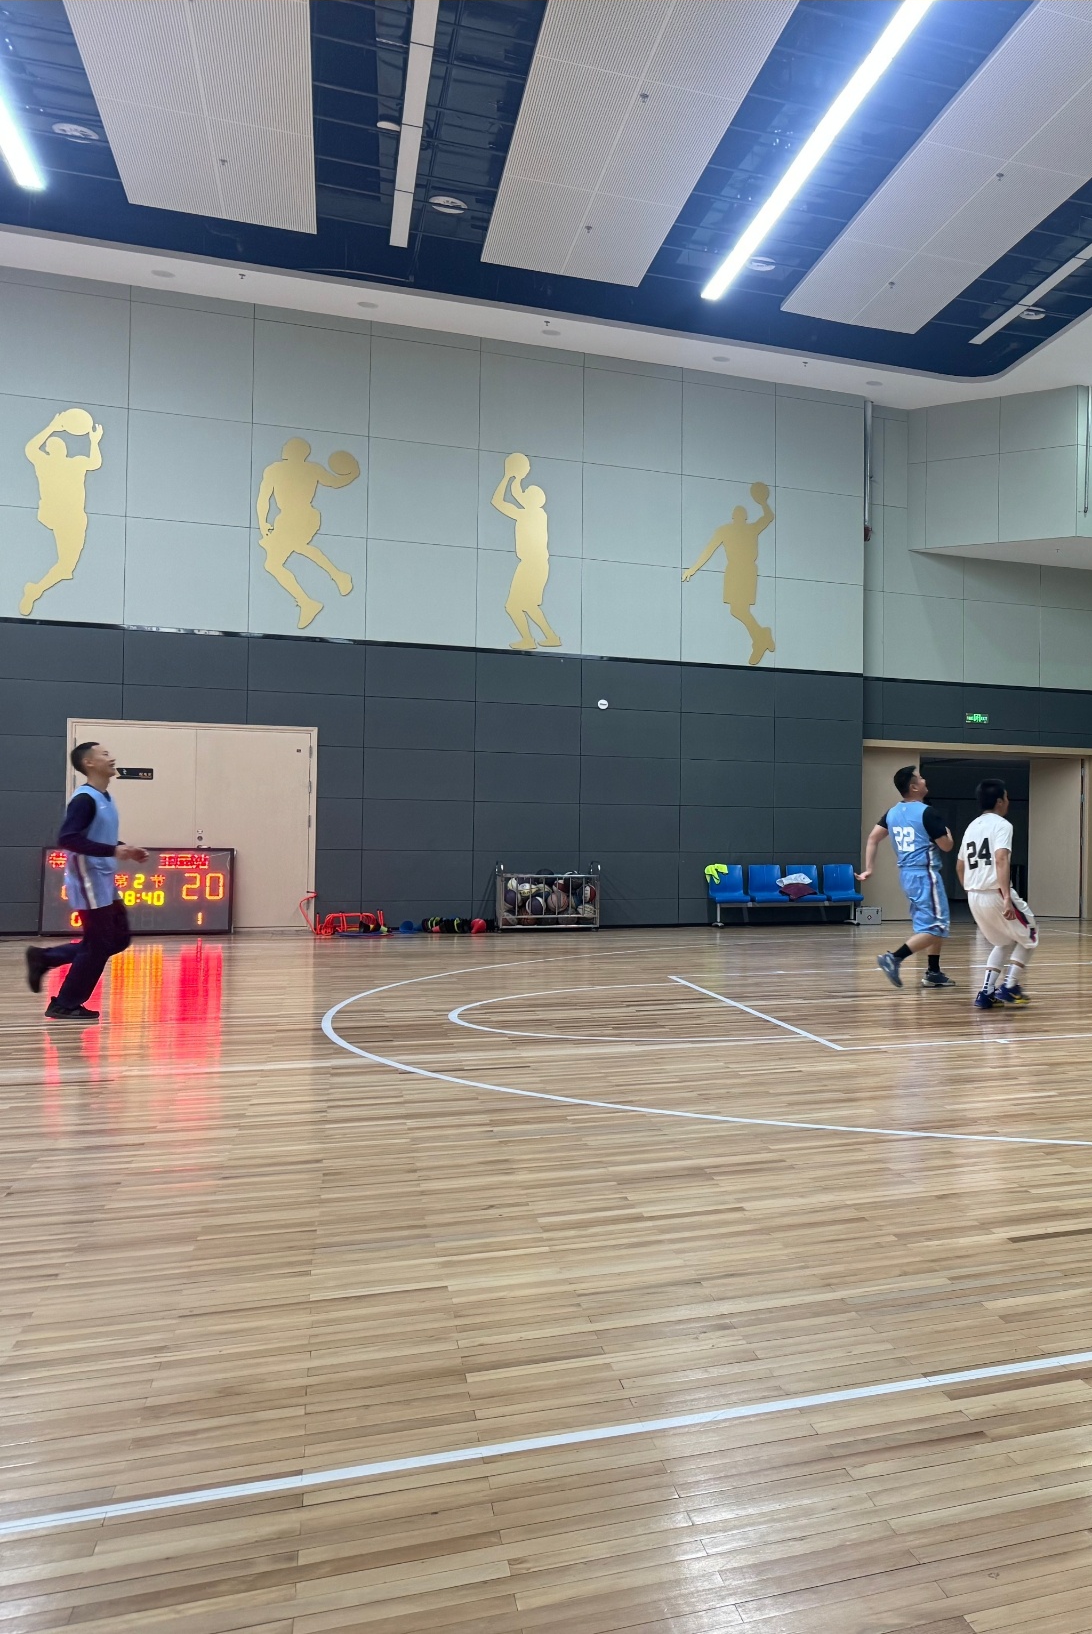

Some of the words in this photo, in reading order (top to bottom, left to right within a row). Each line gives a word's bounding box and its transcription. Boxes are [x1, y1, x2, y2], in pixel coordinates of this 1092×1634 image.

[892, 827, 915, 852] 22
[966, 838, 992, 870] 24
[118, 890, 165, 906] 8:40
[181, 873, 224, 900] 20
